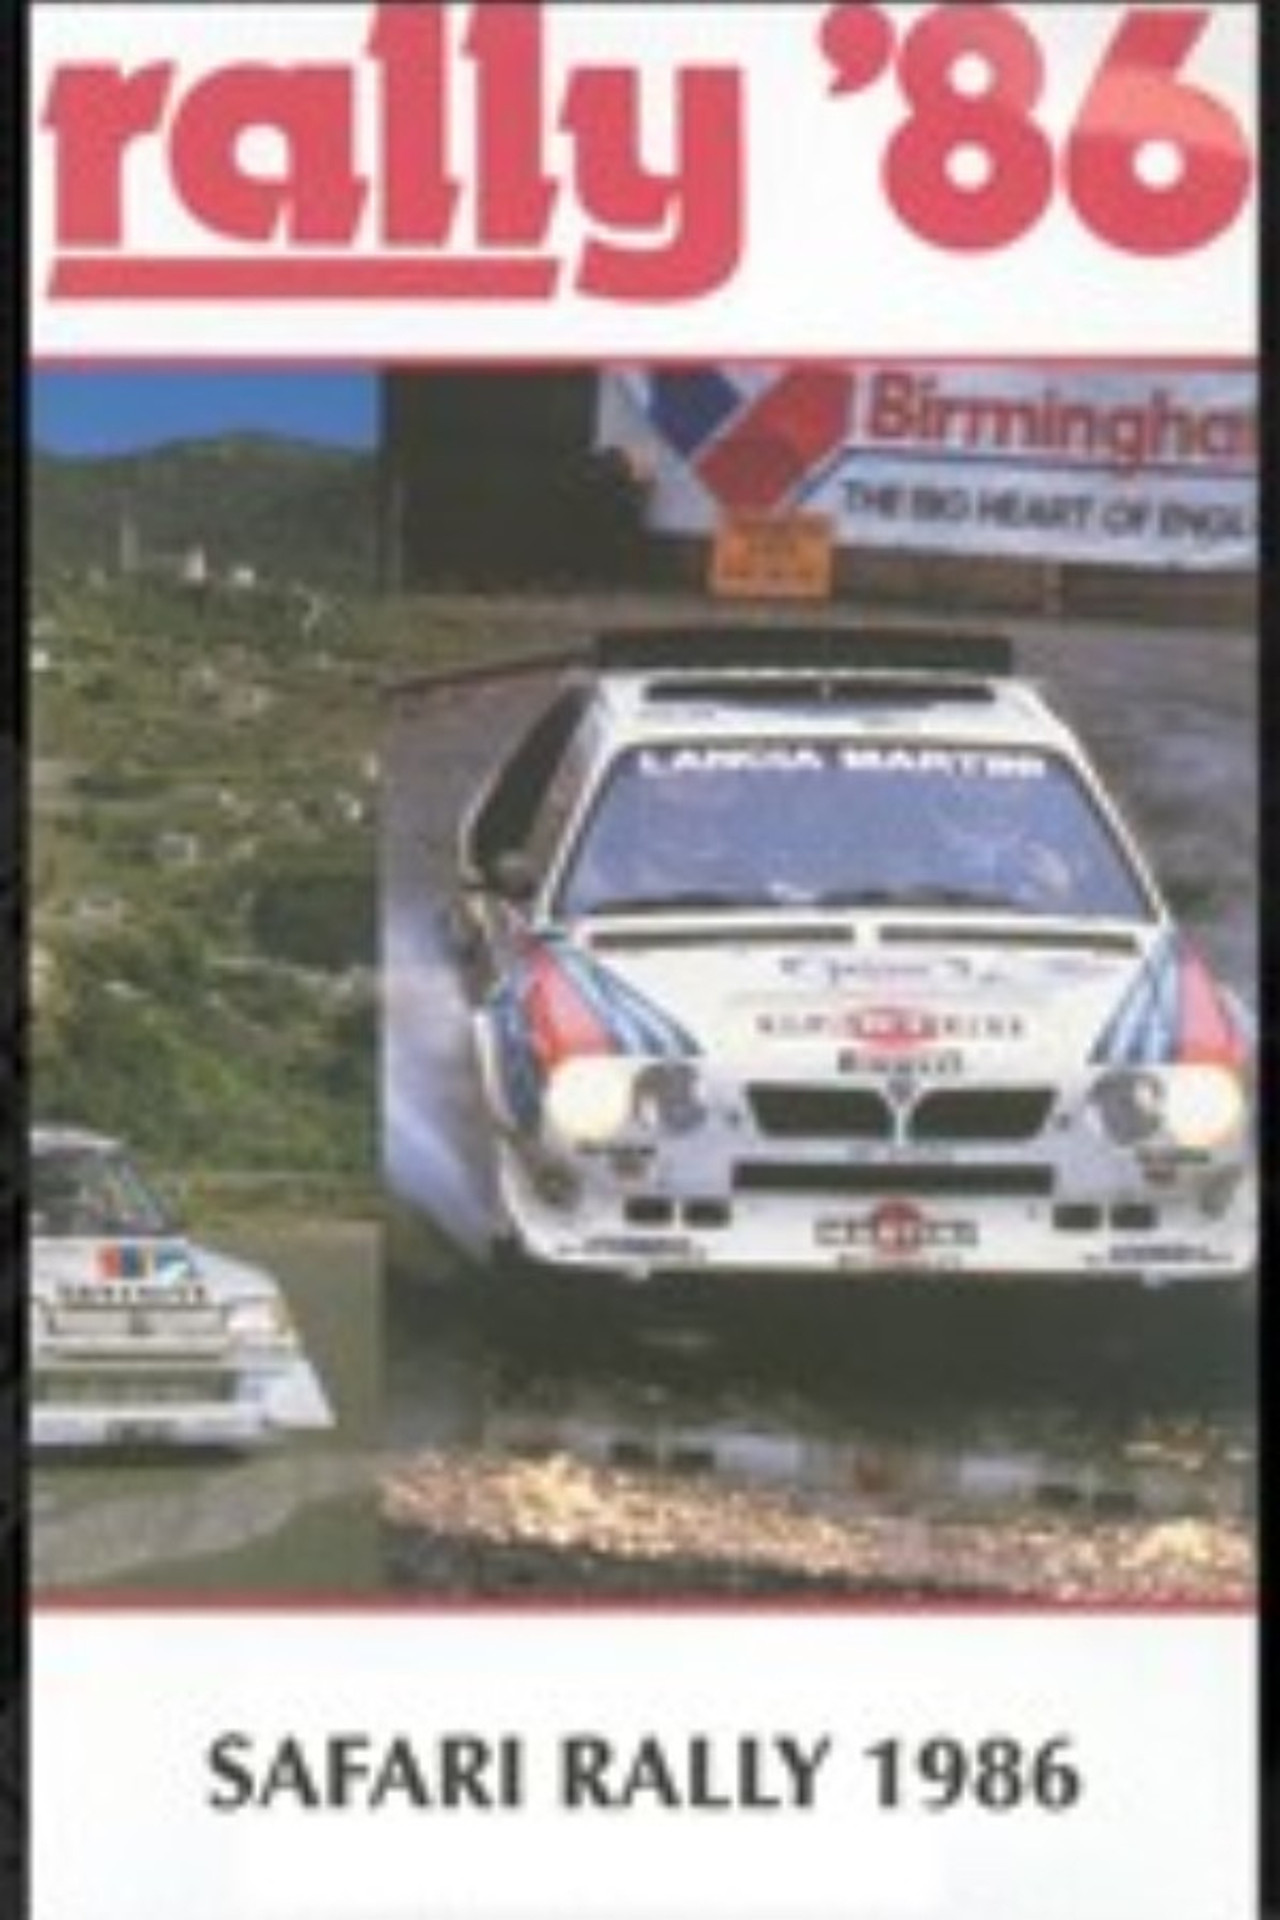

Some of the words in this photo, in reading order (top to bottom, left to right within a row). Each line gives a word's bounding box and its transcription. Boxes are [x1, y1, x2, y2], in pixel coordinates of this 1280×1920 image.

[44, 0, 747, 305] rally
[843, 479, 898, 519] THE
[911, 486, 970, 522] BIG
[978, 488, 1093, 530] HEART
[1102, 497, 1148, 536] OF
[211, 1734, 519, 1807] SAFARI
[564, 1738, 829, 1807] RALLY
[870, 1740, 1079, 1806] 1986
